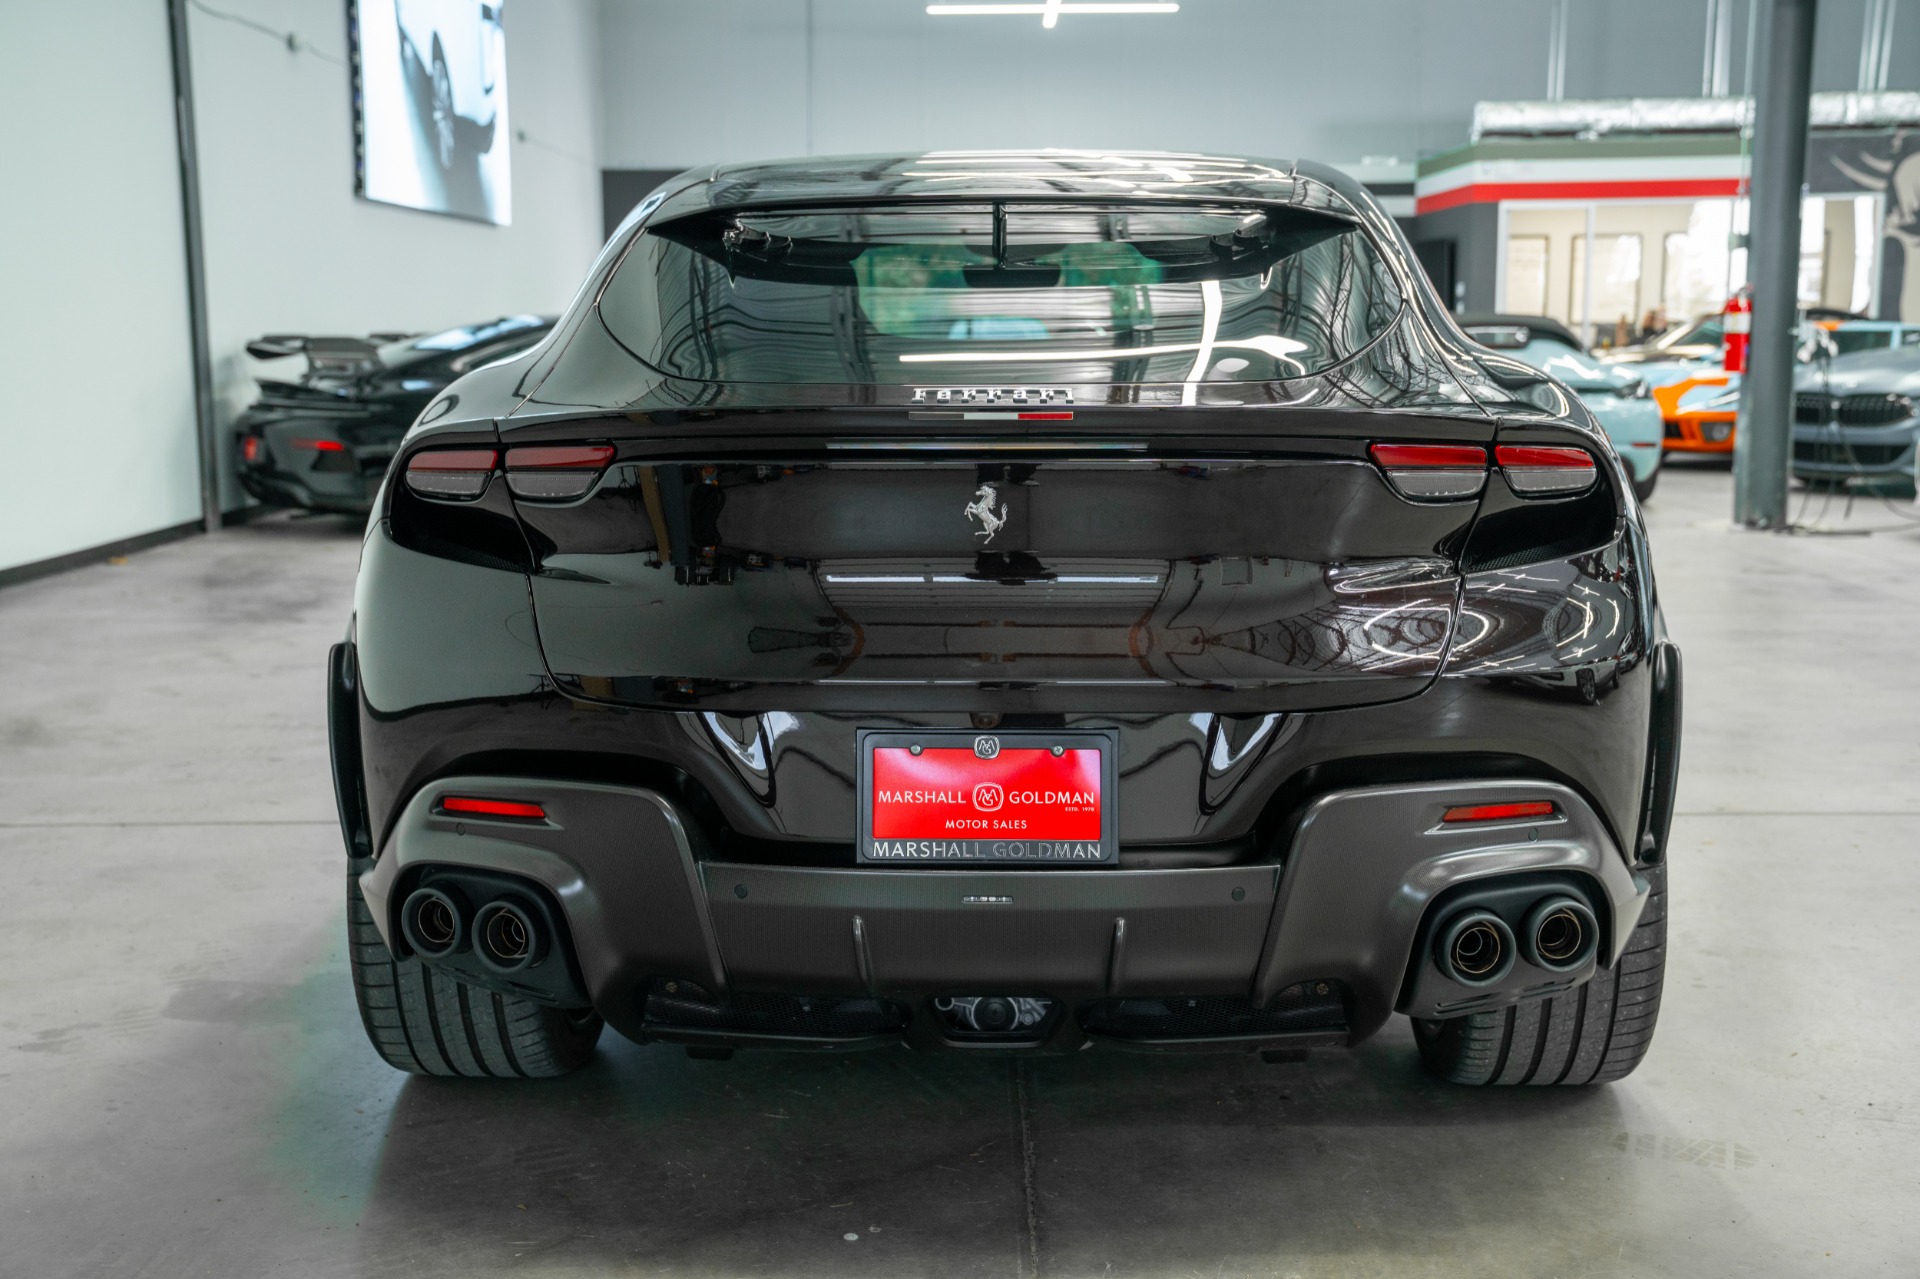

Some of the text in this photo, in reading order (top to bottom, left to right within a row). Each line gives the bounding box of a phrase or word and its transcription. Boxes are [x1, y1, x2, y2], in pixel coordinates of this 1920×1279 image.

[912, 387, 1074, 402] Ferrari
[878, 790, 967, 804] MARSHALL
[1008, 791, 1095, 805] GOLDMAN
[945, 819, 1028, 830] MOTOR SALES
[873, 841, 1101, 859] MARSHALL GOLDMAN
